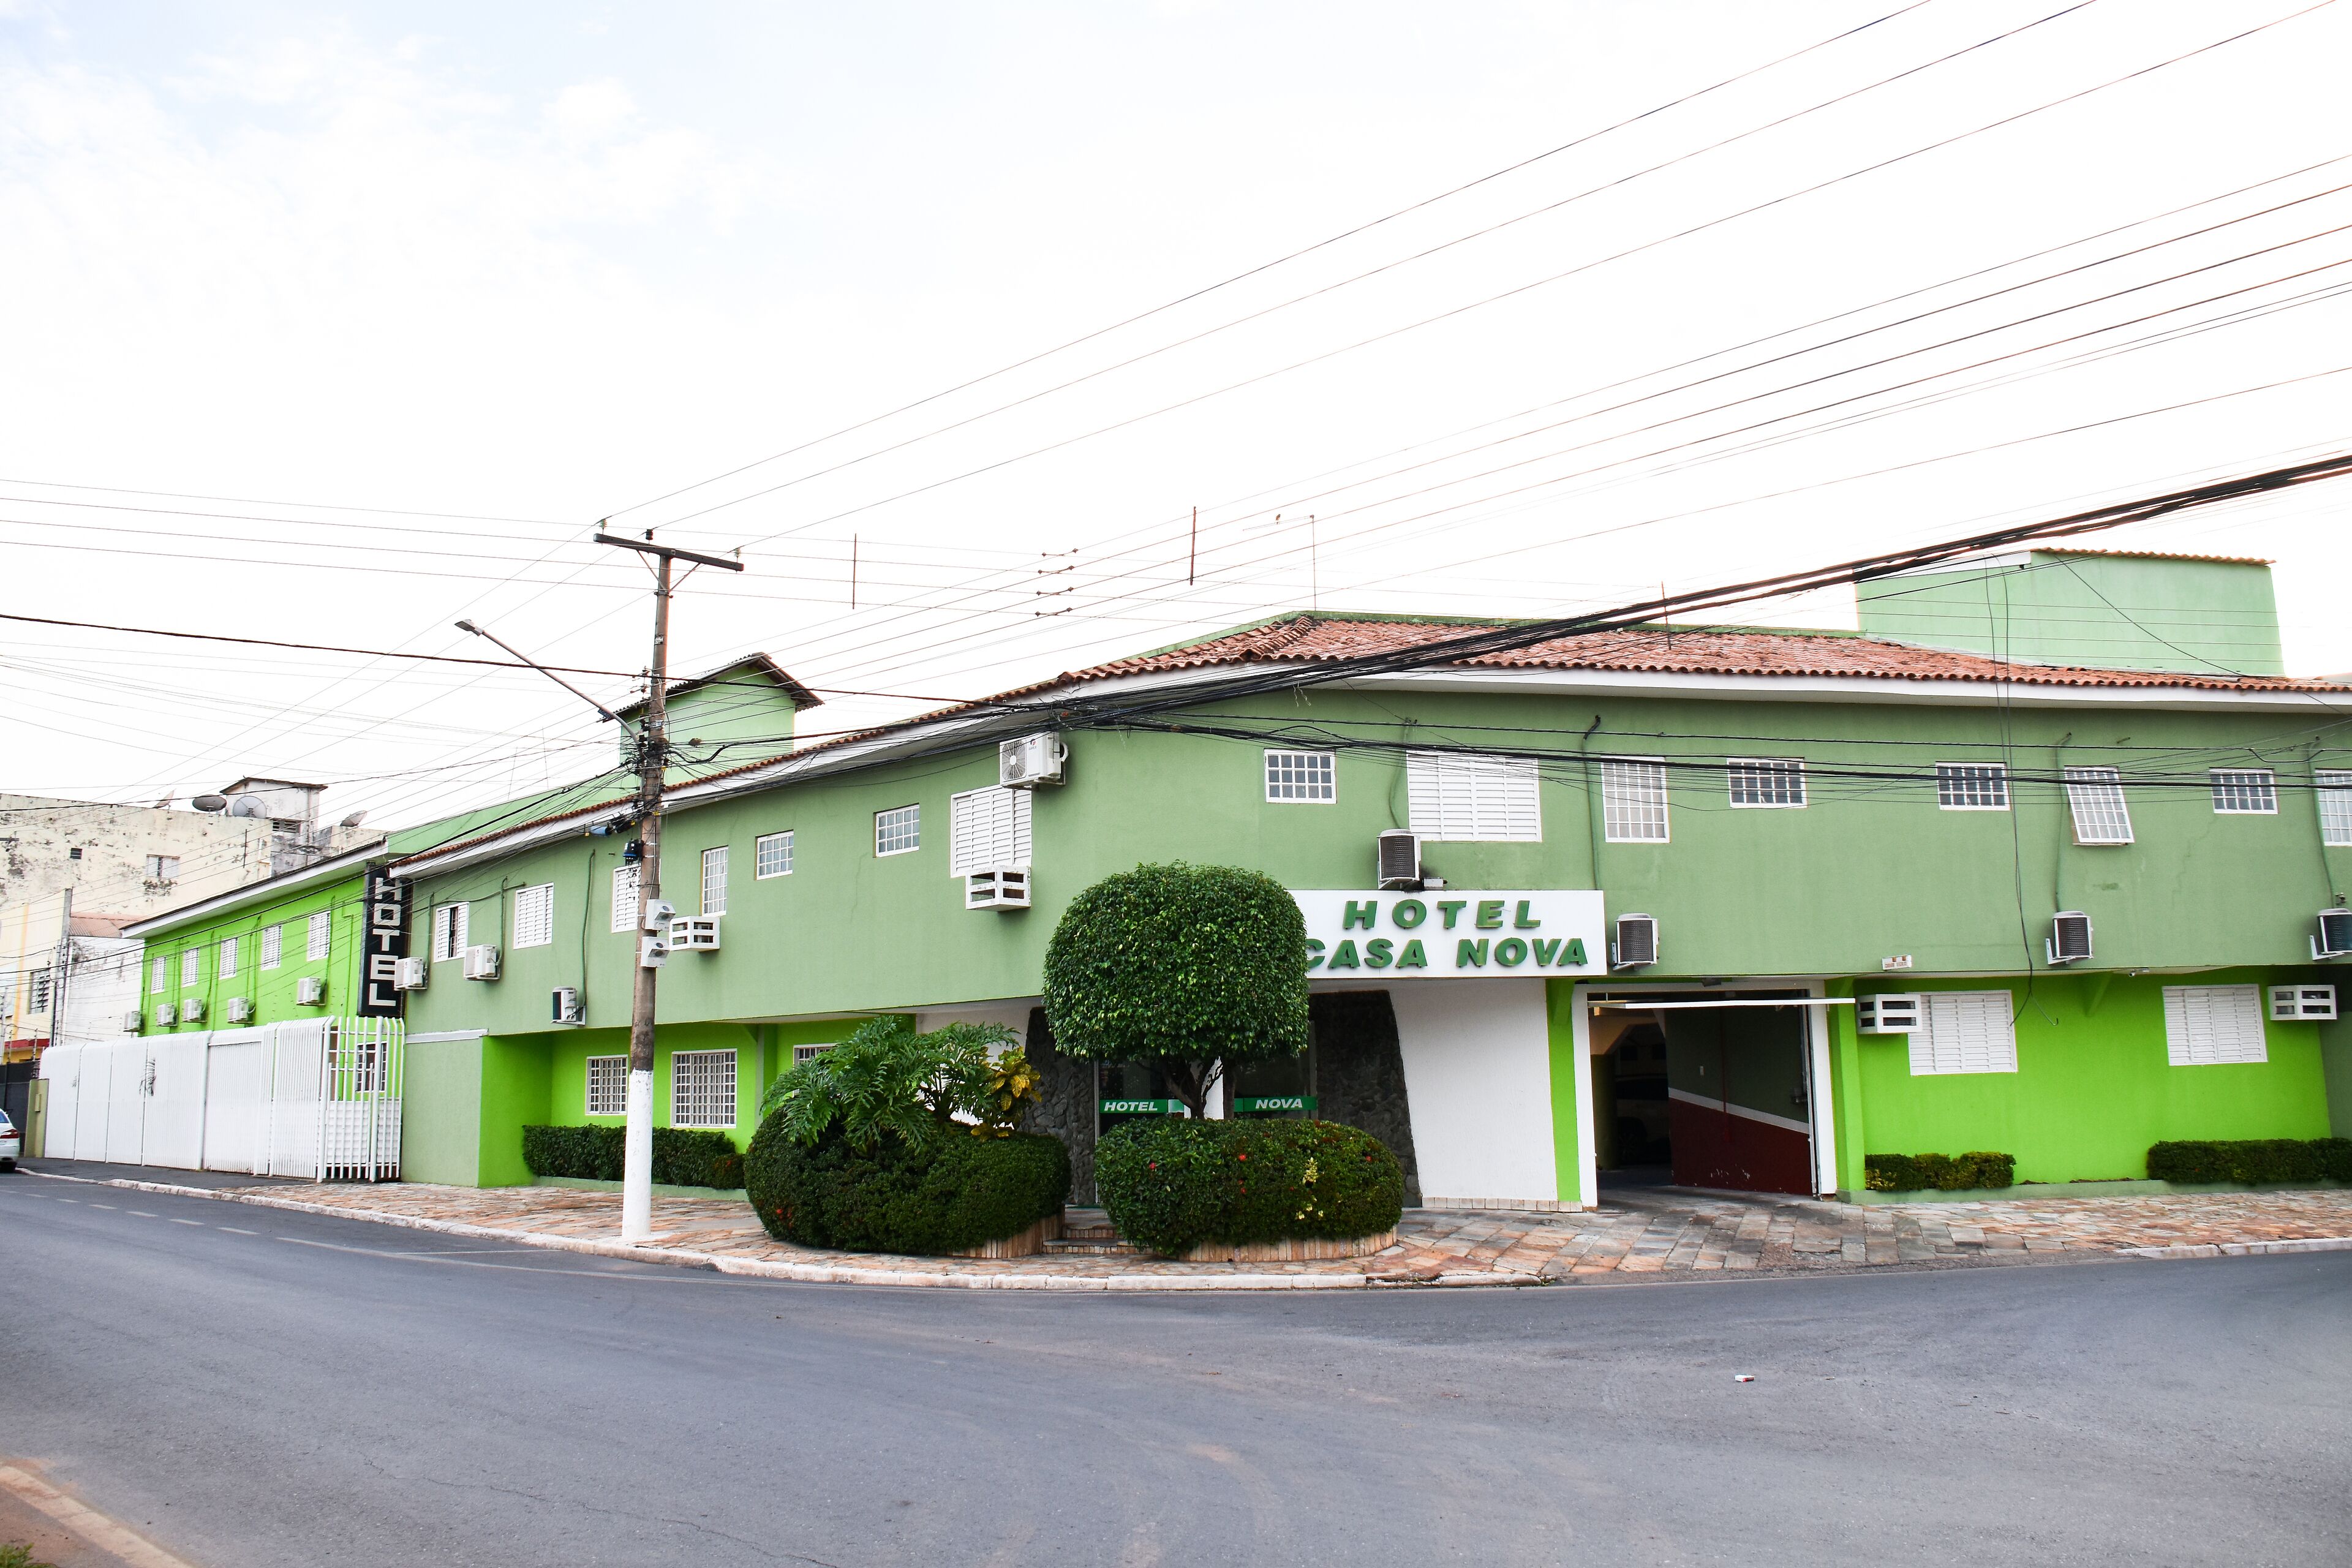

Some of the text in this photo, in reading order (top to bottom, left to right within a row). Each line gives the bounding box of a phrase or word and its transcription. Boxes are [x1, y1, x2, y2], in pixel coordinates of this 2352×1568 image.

[1342, 899, 1541, 930] HOTEL
[369, 877, 402, 1006] HOTEL
[1305, 937, 1588, 968] CASA NOVA
[1104, 1101, 1158, 1112] HOTEL
[1255, 1098, 1303, 1109] NOVA
